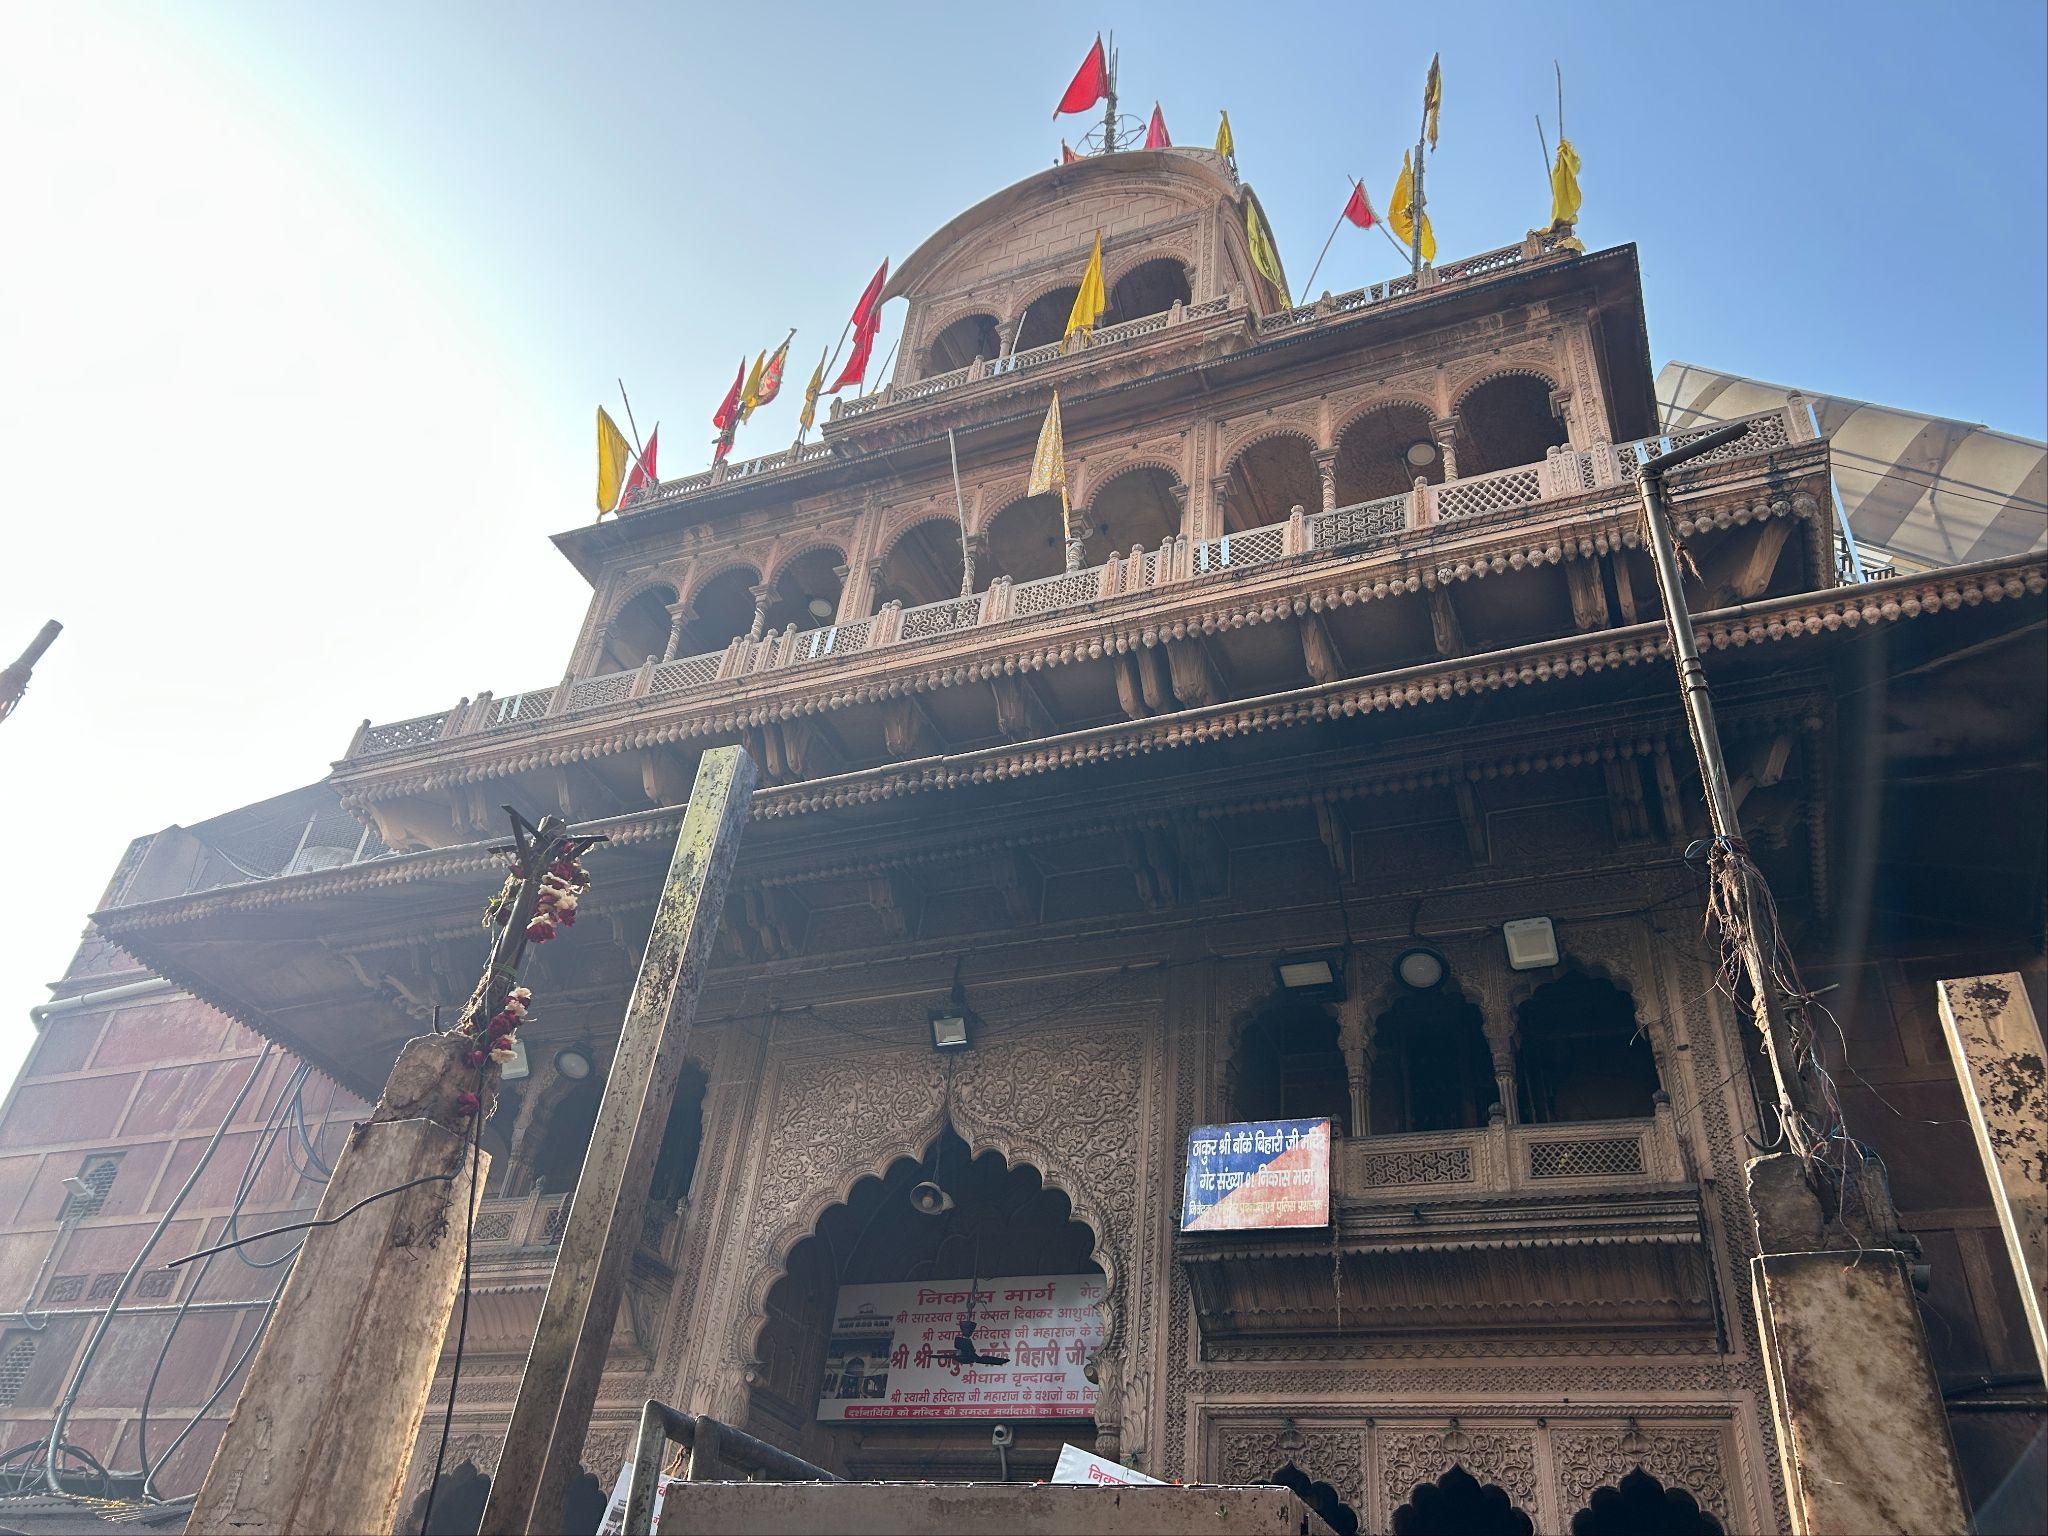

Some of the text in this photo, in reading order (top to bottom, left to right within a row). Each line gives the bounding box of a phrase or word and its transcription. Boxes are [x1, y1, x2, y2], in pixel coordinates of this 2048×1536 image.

[1193, 1139, 1217, 1164] ठाकुर
[1219, 1132, 1231, 1155] श्री
[1233, 1131, 1253, 1153] बाँके
[1255, 1129, 1283, 1154] बिहारी
[1285, 1128, 1299, 1150] जी
[1200, 1168, 1216, 1190] गेट
[1217, 1167, 1244, 1190] संख्या
[1258, 1163, 1291, 1188] निकास
[1277, 1197, 1296, 1217] पुलिस
[917, 1282, 1102, 1305] निकास मार्ग गेट
[896, 1310, 908, 1324] श्री
[911, 1312, 954, 1324] सारस्वत
[1014, 1306, 1054, 1320] दिवाकर
[922, 1328, 934, 1342] श्री
[972, 1325, 1011, 1341] हरिदास
[1015, 1325, 1029, 1338] जी
[1033, 1327, 1076, 1339] महाराज
[1080, 1324, 1094, 1337] के
[890, 1343, 910, 1369] श्री
[914, 1343, 932, 1368] श्री
[1015, 1339, 1060, 1367] बिहारी
[1065, 1339, 1086, 1366] जी
[961, 1370, 1067, 1387] श्रीधाम वृन्दावन
[890, 1388, 901, 1403] श्री
[904, 1388, 930, 1403] स्वामी
[932, 1388, 966, 1403] हरिदास
[968, 1388, 980, 1402] जी
[983, 1390, 1019, 1402] महाराज
[1022, 1387, 1033, 1401] के
[1066, 1390, 1079, 1401] का
[897, 1406, 910, 1416] को
[912, 1406, 940, 1416] मन्दिर
[944, 1405, 956, 1416] की
[959, 1407, 990, 1416] समस्त
[1039, 1406, 1052, 1415] का
[1056, 1407, 1084, 1415] पालन
